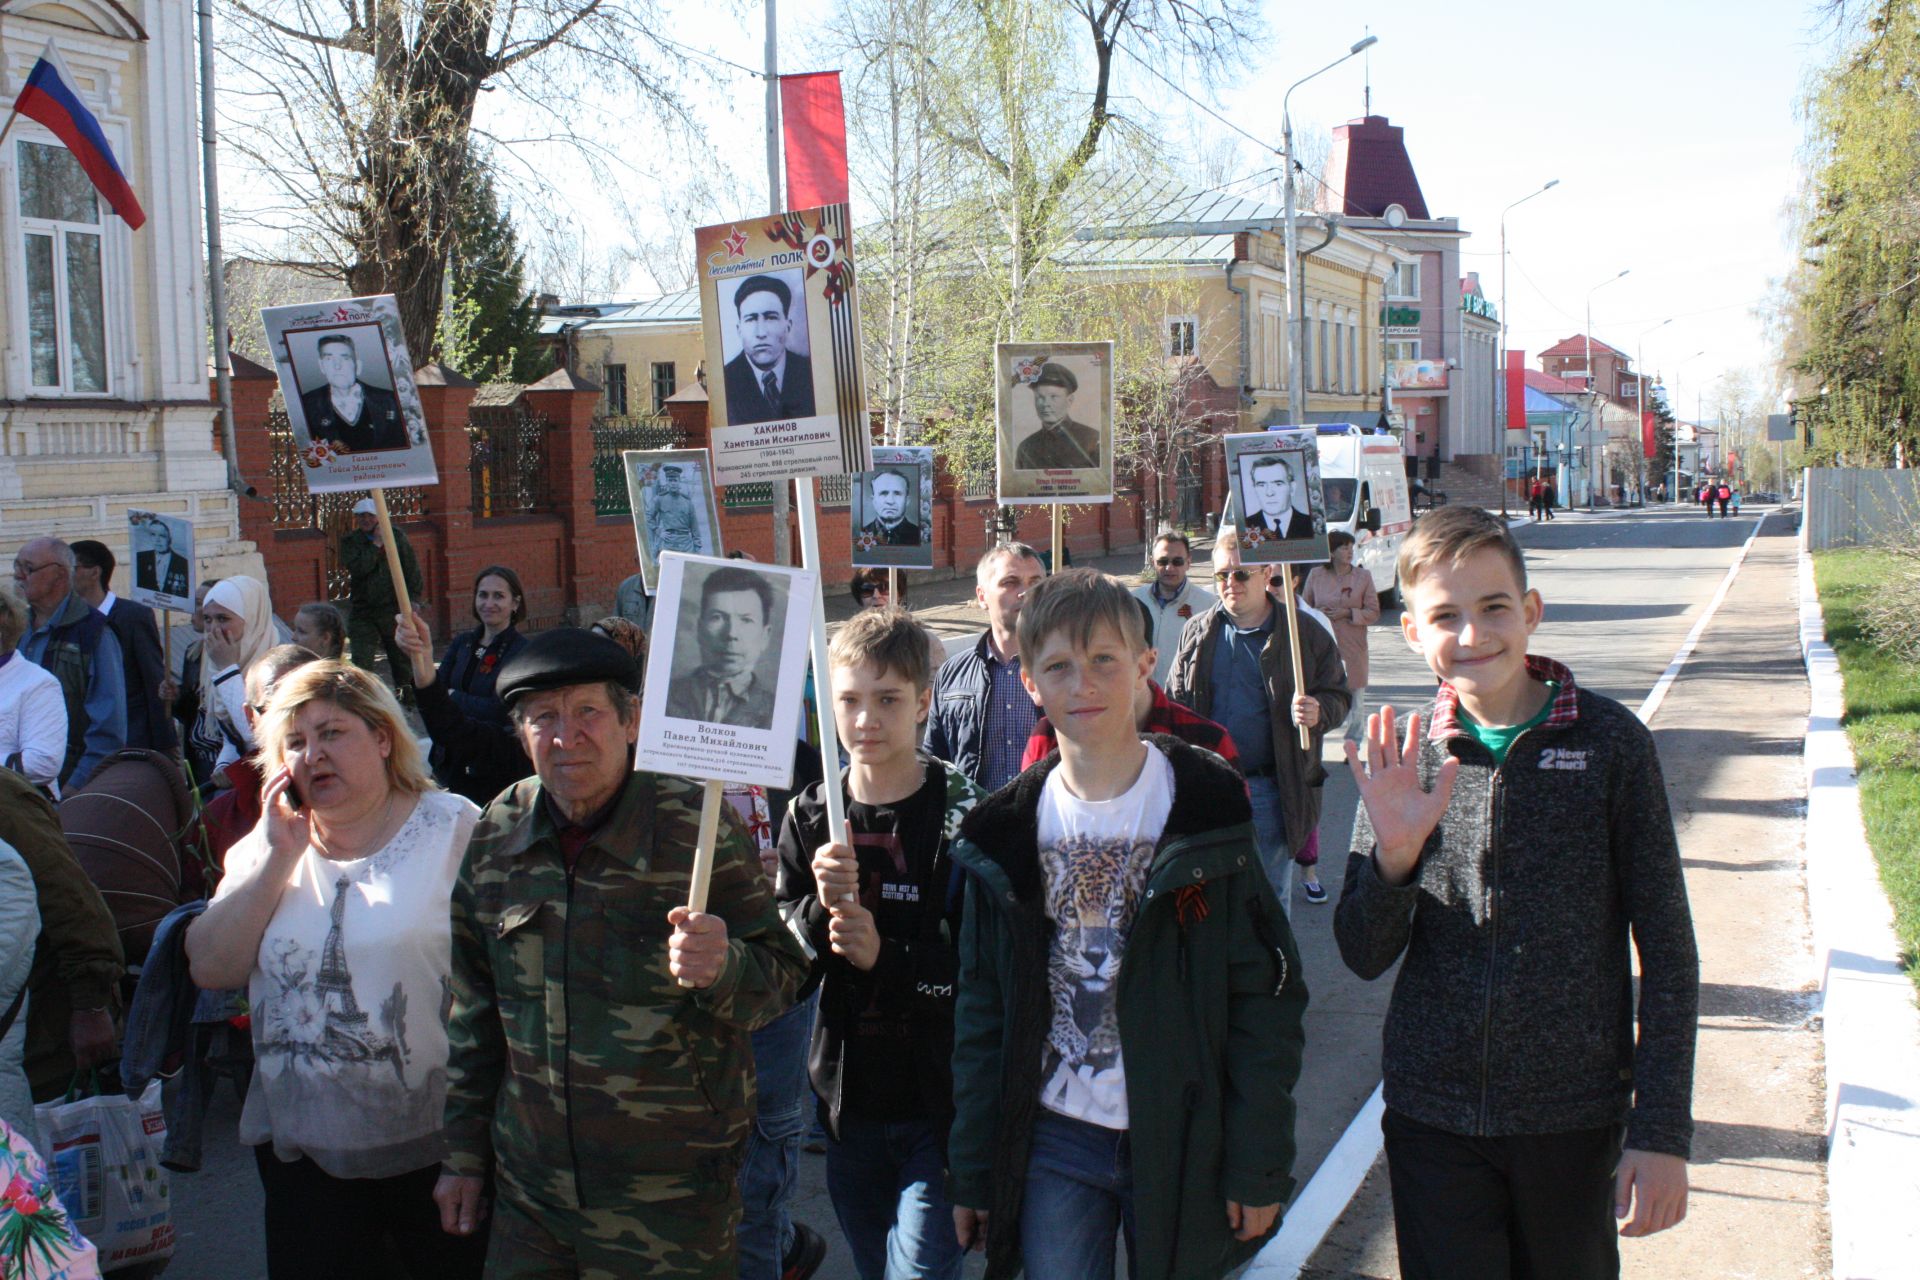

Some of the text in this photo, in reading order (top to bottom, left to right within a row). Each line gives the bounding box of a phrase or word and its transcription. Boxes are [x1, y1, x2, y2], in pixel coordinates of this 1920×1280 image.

[753, 422, 798, 436] ХАКИМОВ
[723, 431, 831, 450] Хаметвали Исмагилович
[698, 724, 736, 737] Волков
[663, 730, 768, 752] Павел Михайлович
[1557, 748, 1587, 759] Never
[1556, 759, 1587, 770] much
